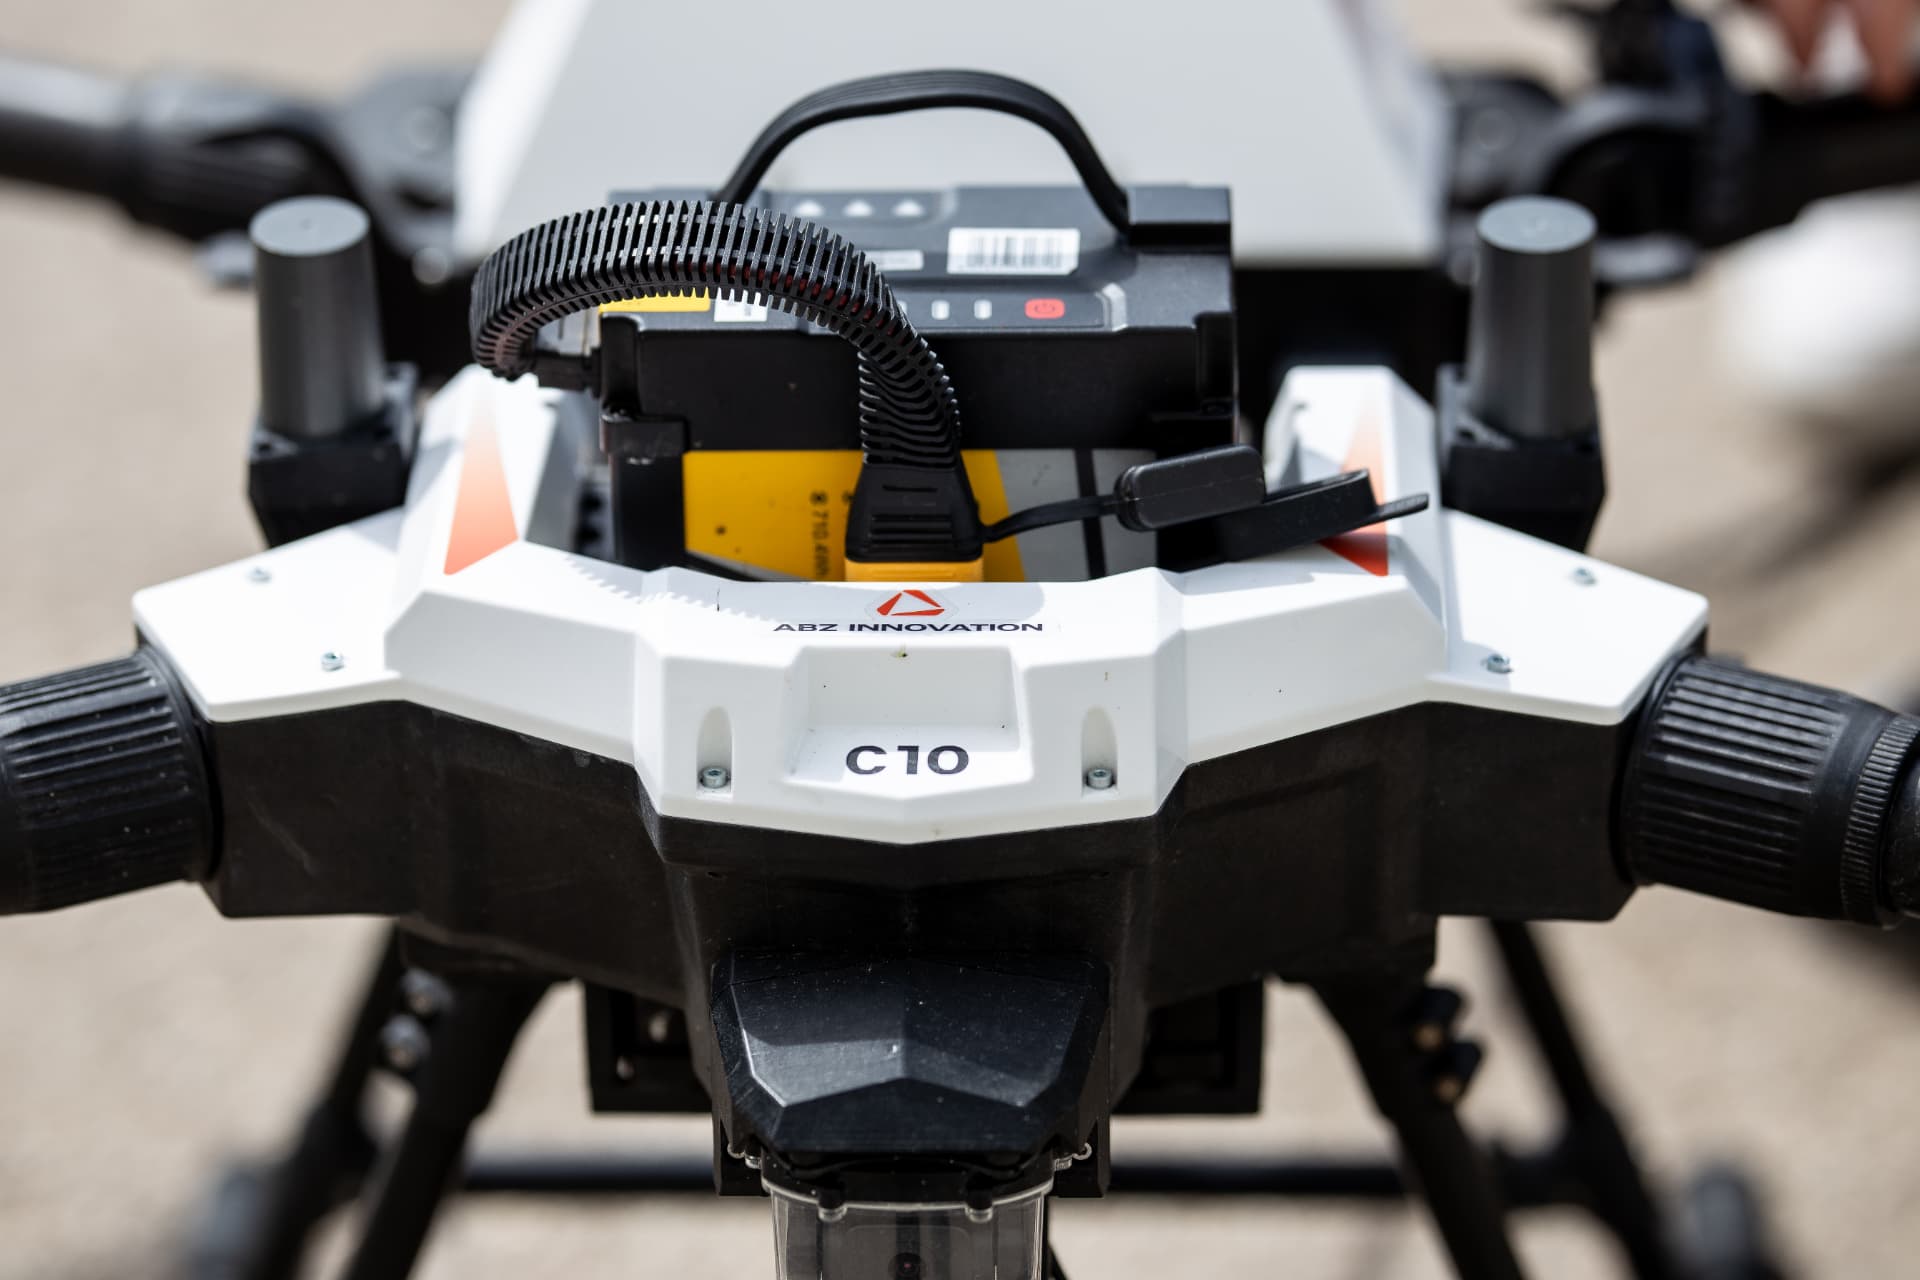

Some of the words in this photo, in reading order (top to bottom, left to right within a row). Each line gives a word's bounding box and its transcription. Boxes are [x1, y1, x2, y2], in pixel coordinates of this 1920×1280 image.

[773, 623, 838, 632] ABZ
[848, 623, 1043, 632] INNOVATION
[845, 744, 969, 775] C10
